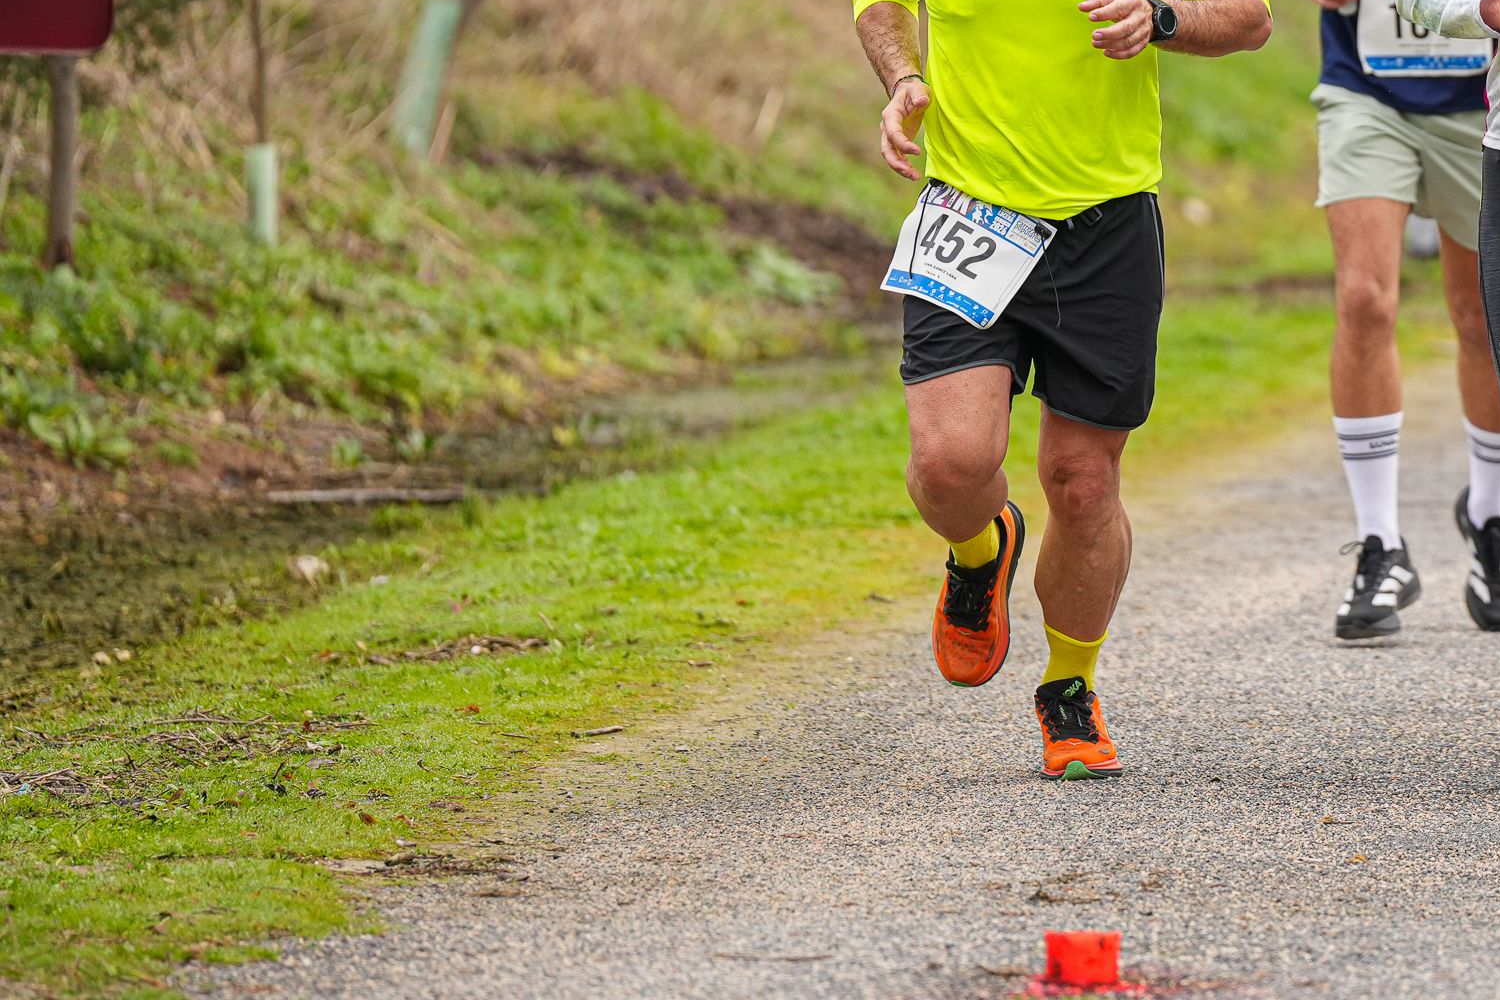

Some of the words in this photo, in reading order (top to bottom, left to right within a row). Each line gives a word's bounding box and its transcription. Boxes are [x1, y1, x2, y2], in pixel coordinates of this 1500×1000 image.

[990, 221, 1008, 236] 2026
[920, 213, 997, 280] 452
[1062, 680, 1083, 697] OKA
